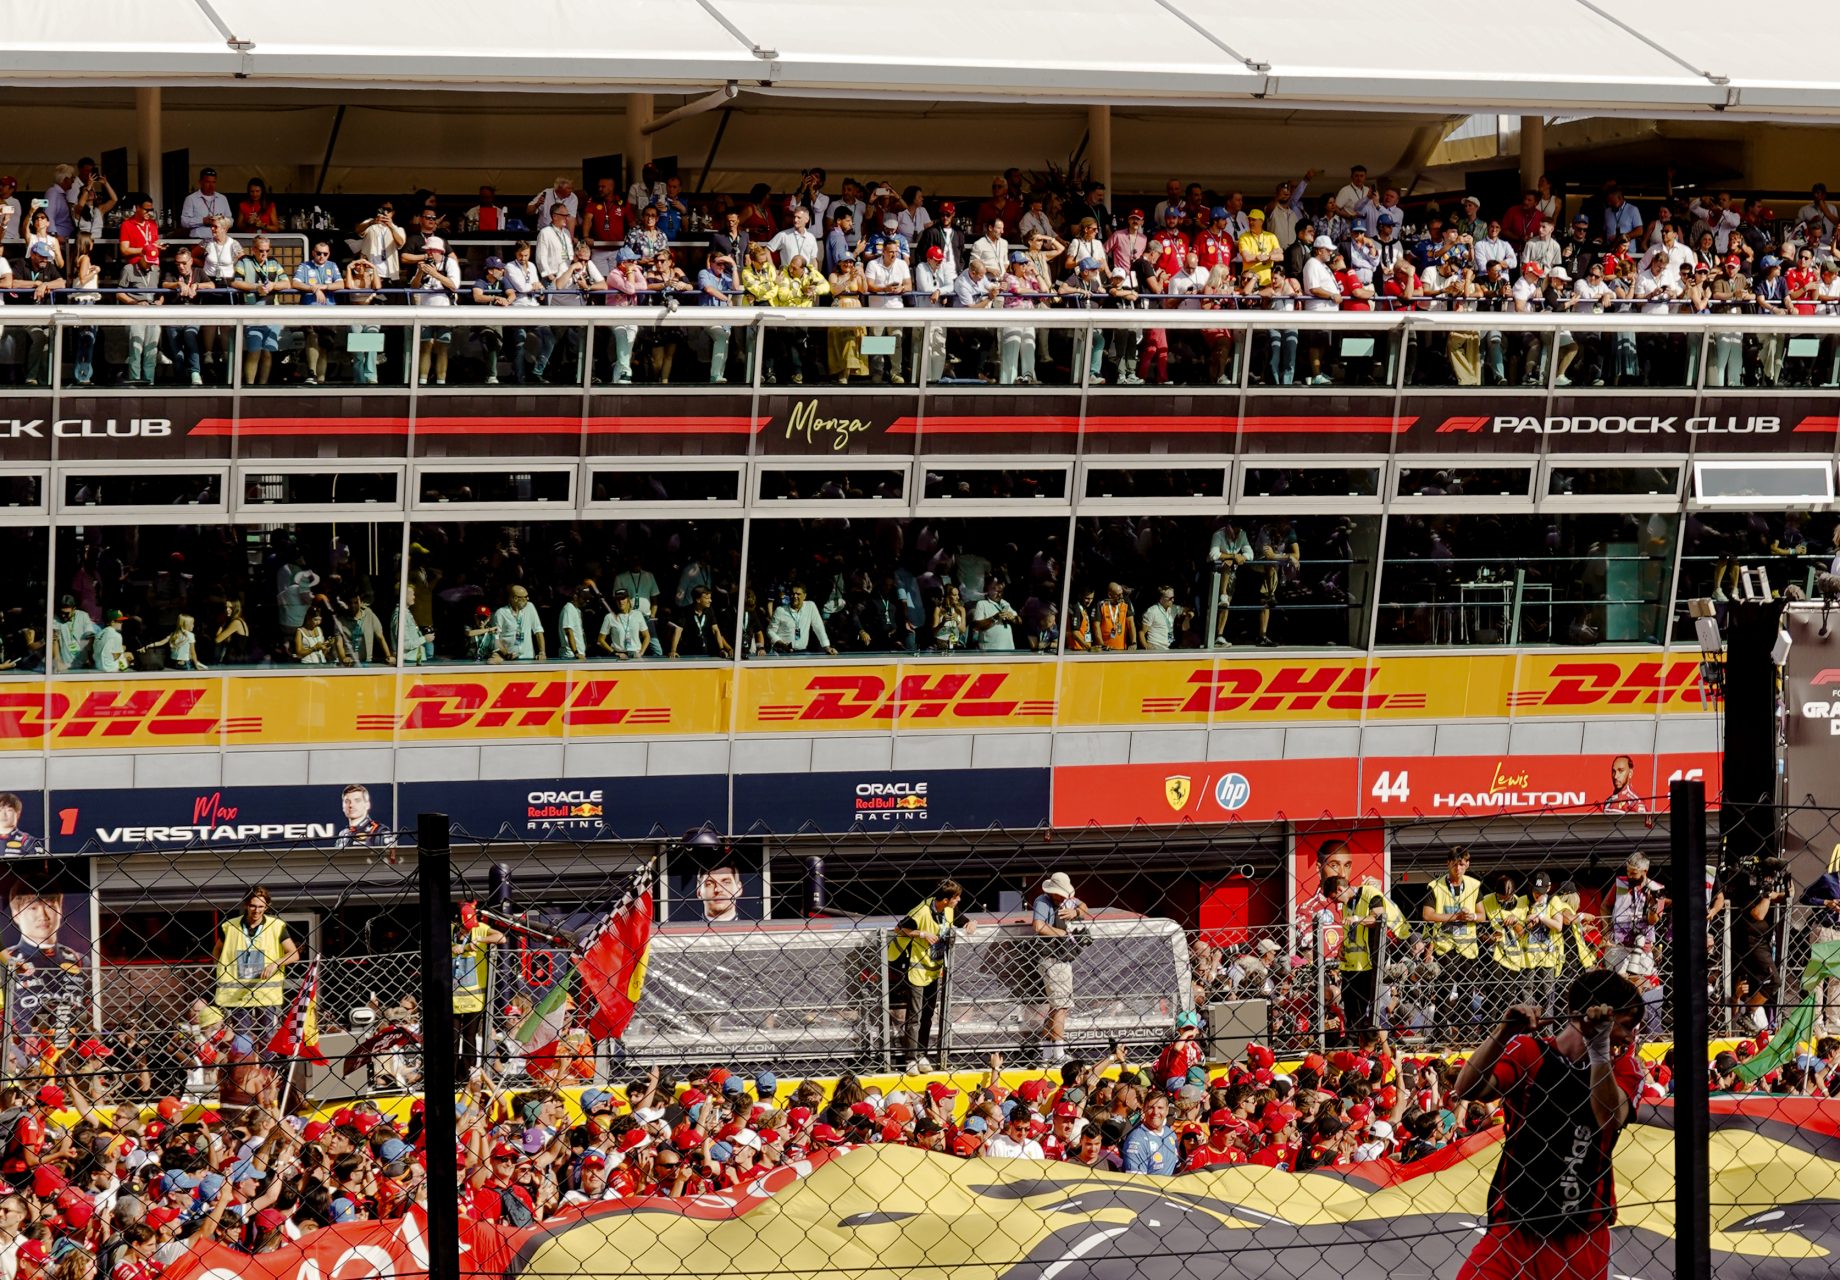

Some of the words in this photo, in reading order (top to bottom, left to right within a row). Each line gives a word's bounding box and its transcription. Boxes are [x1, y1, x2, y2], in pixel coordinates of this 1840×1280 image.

[53, 418, 172, 437] CLUB
[786, 399, 871, 450] Monza
[1493, 416, 1678, 434] PADDOCK
[1685, 416, 1780, 434] CLUB
[402, 680, 626, 730] DHL
[800, 673, 1019, 720] DHL
[1180, 666, 1387, 712] DHL
[0, 688, 221, 738] DHL
[855, 782, 928, 796] ORACLE
[1220, 776, 1246, 808] hp
[1371, 770, 1410, 803] 44
[1490, 762, 1529, 794] Lewis
[193, 791, 239, 827] Max
[527, 790, 604, 804] ORACLE
[1433, 791, 1586, 808] HAMILTON
[58, 807, 79, 835] 1
[96, 821, 334, 843] VERSTAPPEN
[527, 820, 604, 830] RACING
[855, 811, 928, 821] RACING
[1561, 1124, 1593, 1215] adidas
